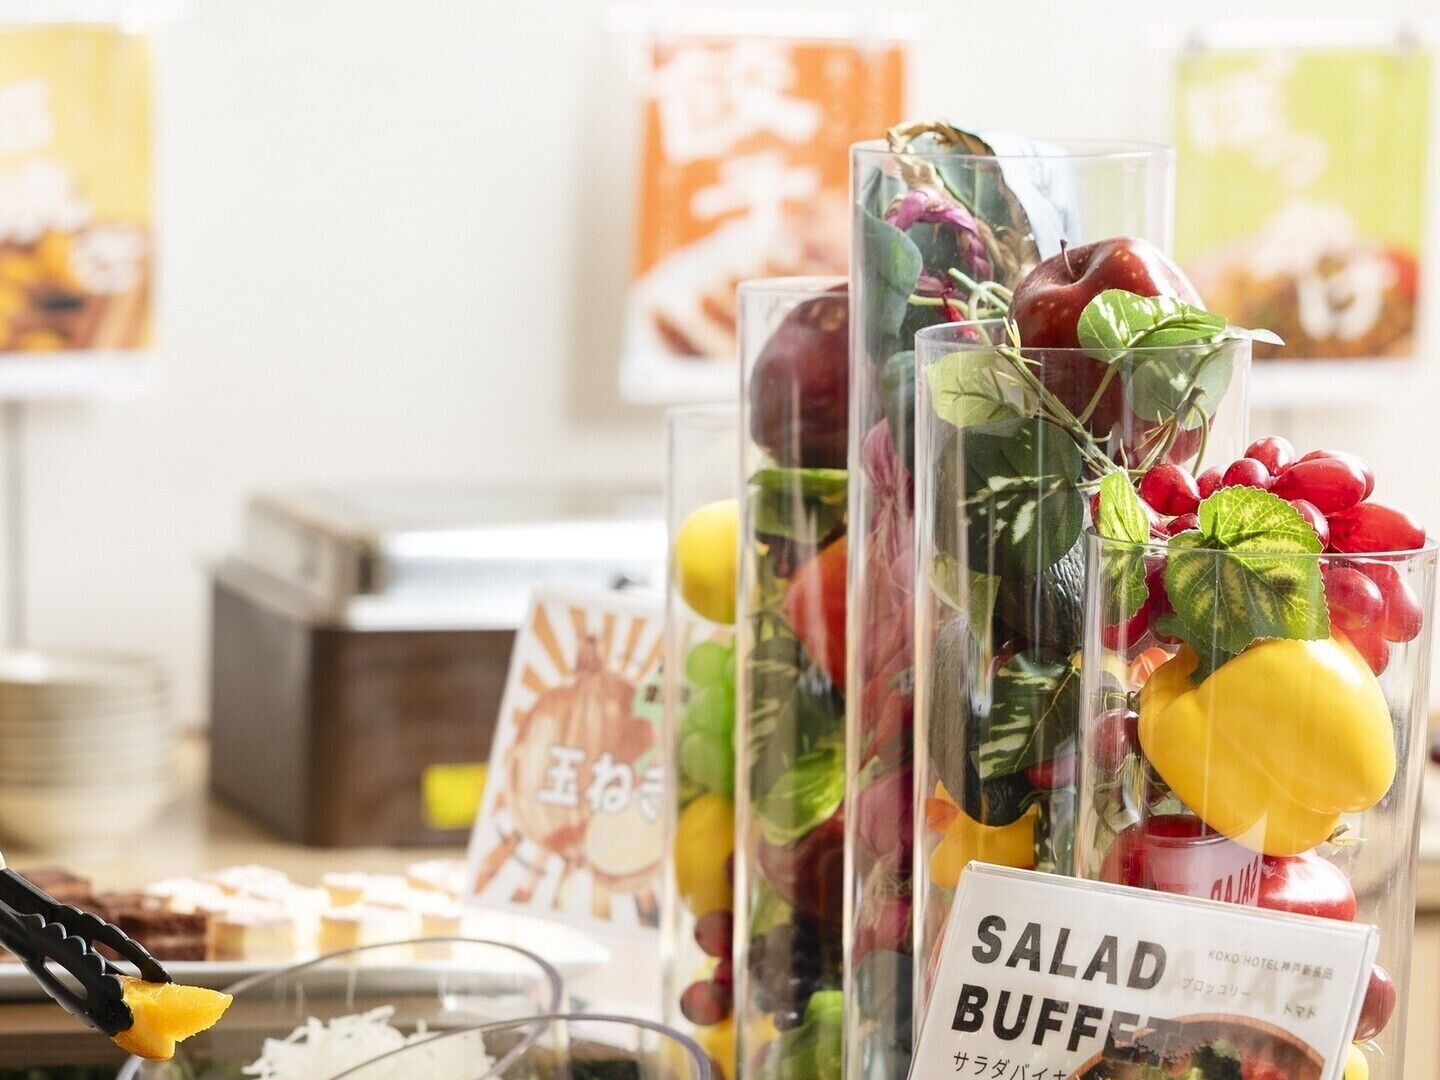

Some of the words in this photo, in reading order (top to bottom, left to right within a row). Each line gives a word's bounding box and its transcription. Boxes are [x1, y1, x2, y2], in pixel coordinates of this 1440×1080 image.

[971, 914, 1168, 991] SALAD
[1209, 950, 1240, 964] KOKO
[1282, 1002, 1318, 1021] トマト
